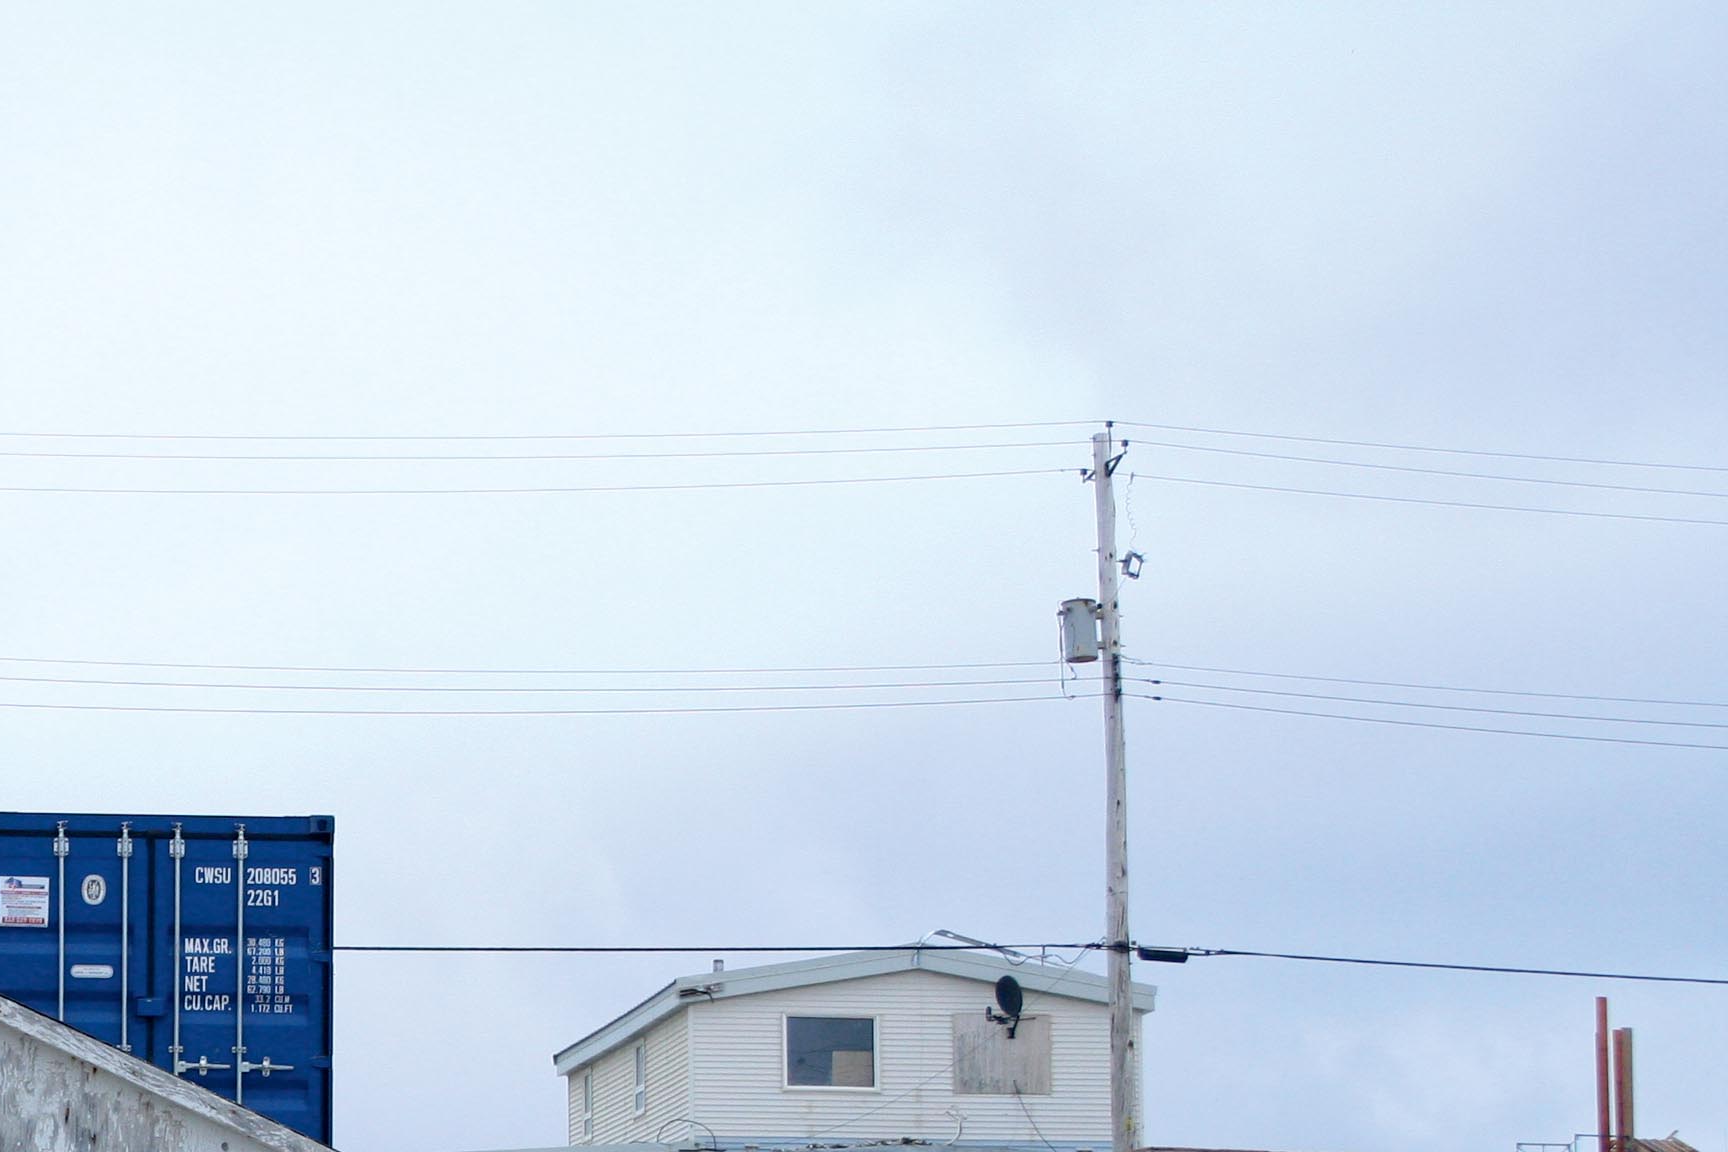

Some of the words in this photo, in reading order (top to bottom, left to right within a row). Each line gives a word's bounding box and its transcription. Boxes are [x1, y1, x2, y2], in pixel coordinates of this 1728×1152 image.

[195, 867, 231, 884] CWSU
[247, 868, 297, 885] 208055
[247, 889, 279, 906] 22G1
[184, 938, 232, 954] MAX.GR.
[185, 956, 215, 973] TARE
[184, 976, 208, 992] NET
[184, 995, 232, 1011] CU.CAP.
